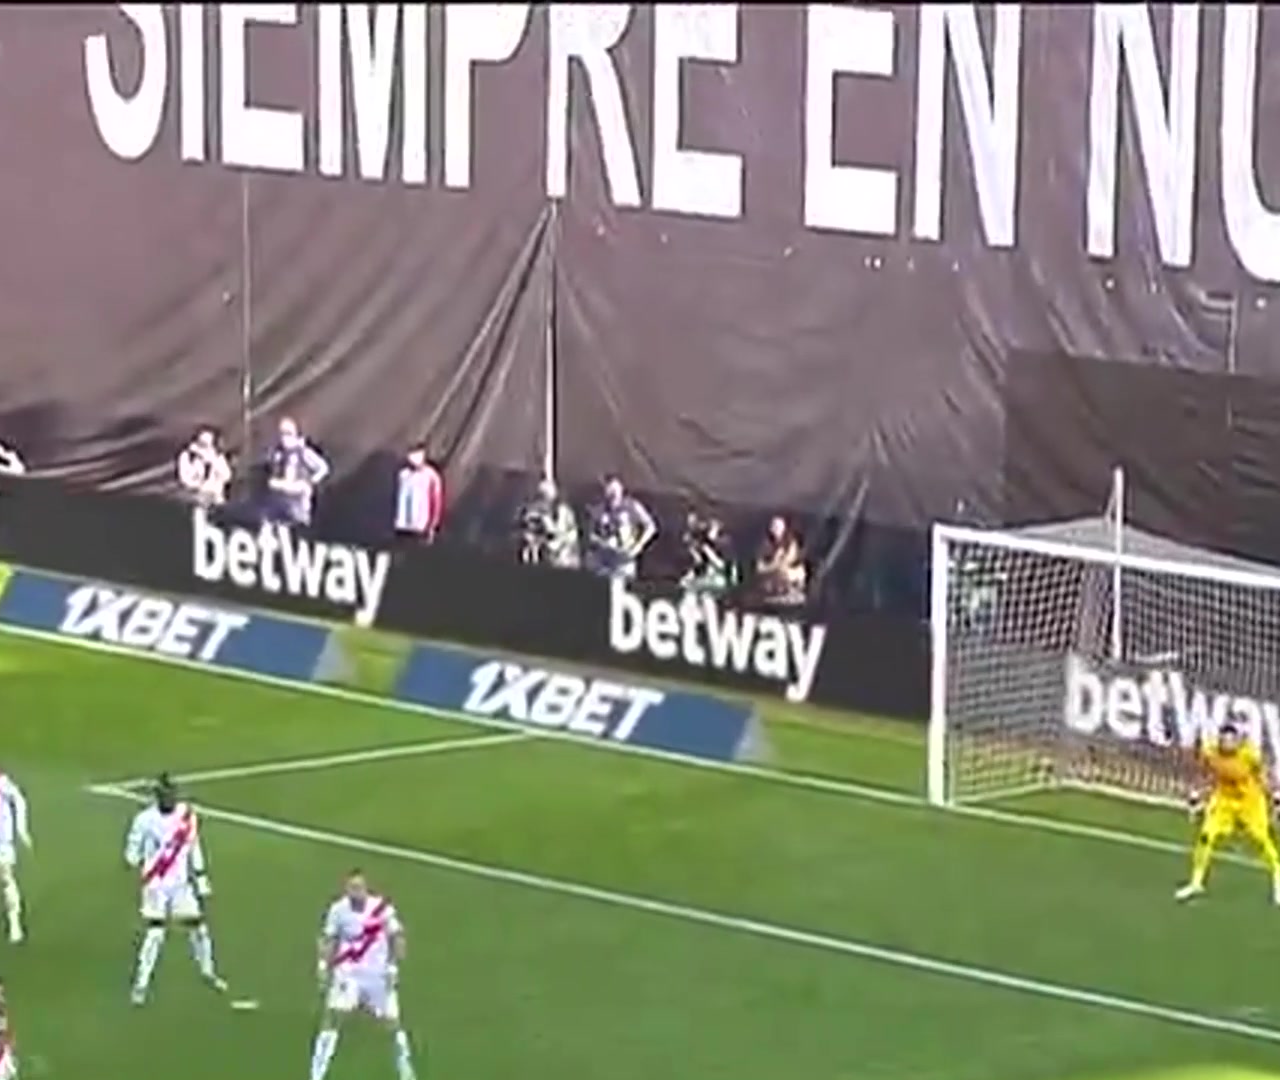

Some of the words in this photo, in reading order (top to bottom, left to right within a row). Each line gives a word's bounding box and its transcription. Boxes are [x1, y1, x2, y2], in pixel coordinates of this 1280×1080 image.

[803, 3, 1021, 247] EN
[58, 586, 249, 661] 1XBET
[192, 509, 390, 627] betway
[608, 576, 826, 700] betway
[463, 662, 664, 742] 1XBET
